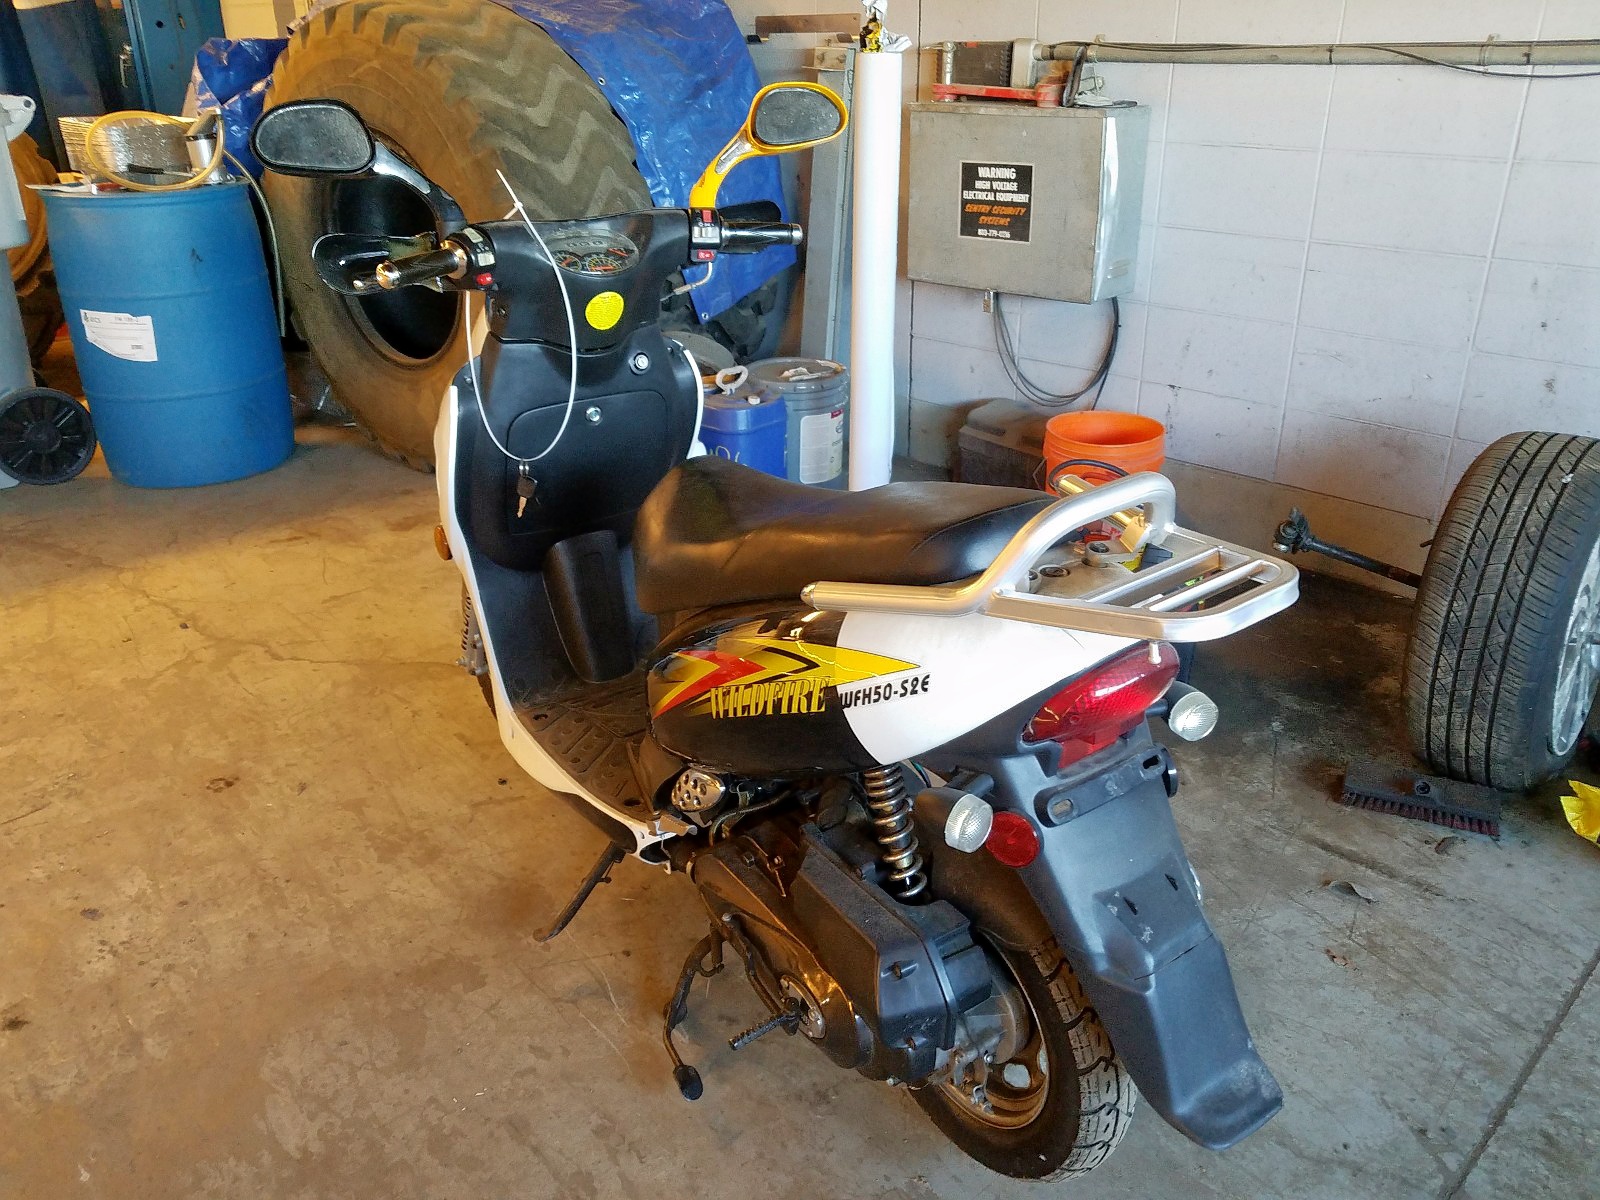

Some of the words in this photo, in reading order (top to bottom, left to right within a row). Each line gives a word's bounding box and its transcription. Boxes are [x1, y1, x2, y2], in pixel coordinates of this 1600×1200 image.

[978, 166, 1016, 179] WARNING
[975, 180, 990, 190] HIGH
[992, 181, 1018, 191] VOLTAGE
[963, 190, 995, 200] ELECTRICAL
[996, 192, 1029, 203] EQUIPMENT
[991, 206, 1026, 216] SECURITY
[710, 677, 829, 720] WILDFIRE
